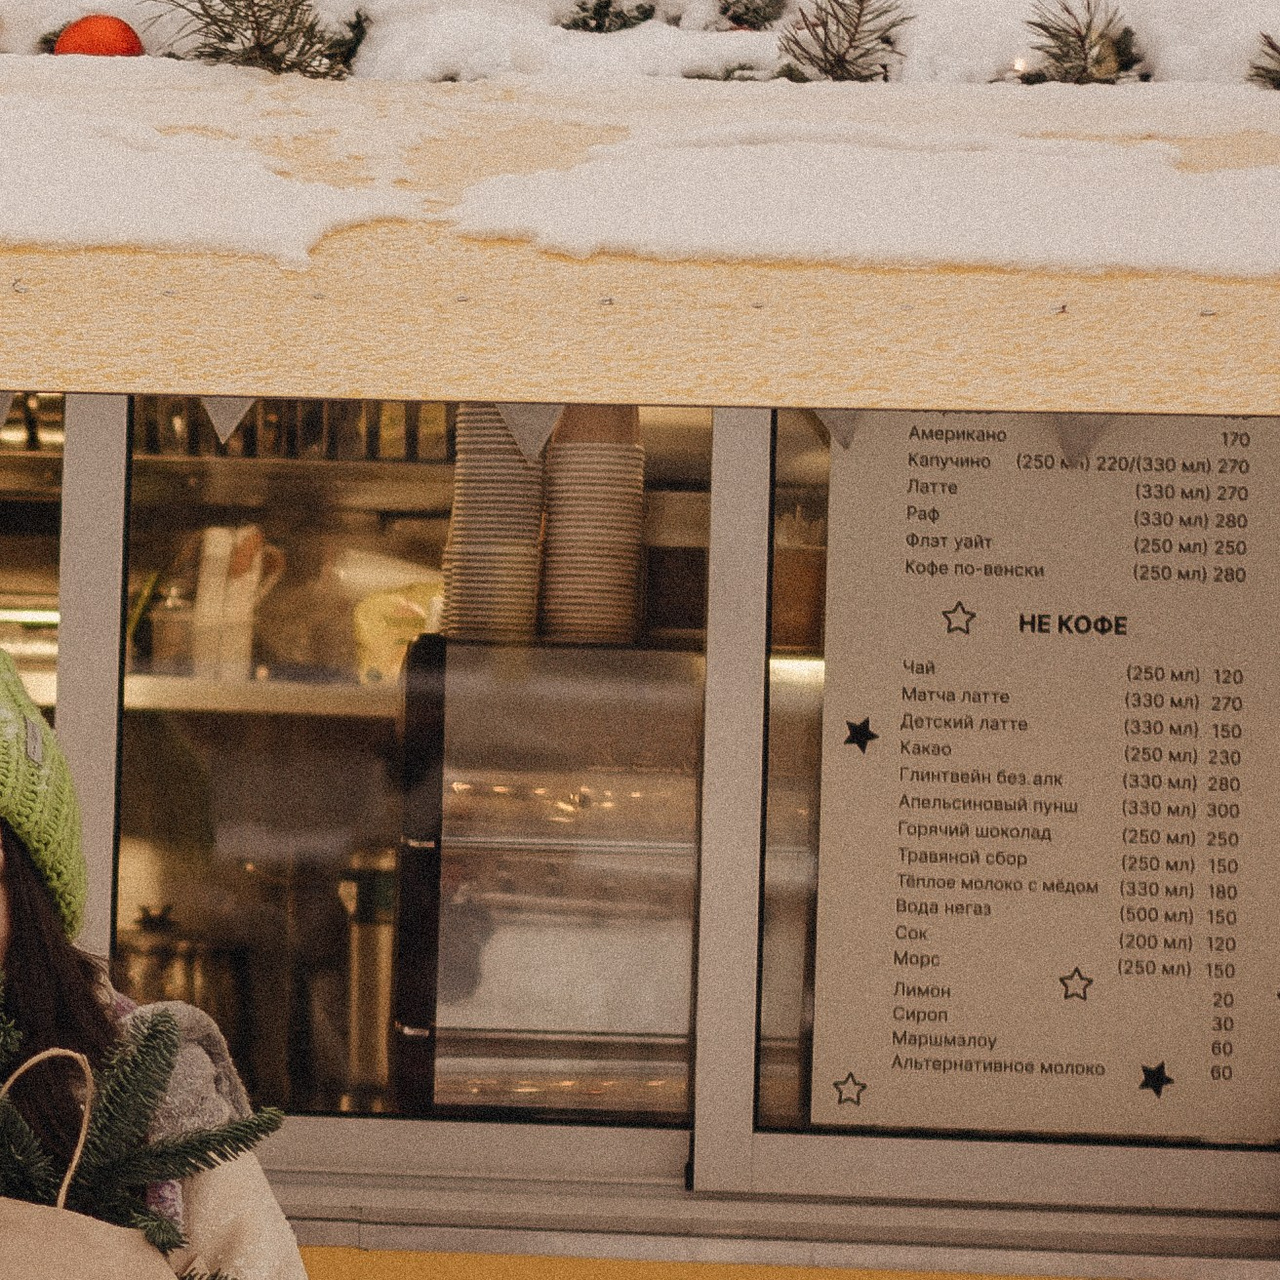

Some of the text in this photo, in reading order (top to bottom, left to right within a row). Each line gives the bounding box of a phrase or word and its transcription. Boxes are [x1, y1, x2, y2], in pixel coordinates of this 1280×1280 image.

[908, 425, 1250, 447] Американо 170
[908, 453, 991, 470] Капучино
[1016, 454, 1055, 470] (250
[1097, 455, 1176, 473] 220/(330
[1181, 457, 1211, 473] мл)
[1217, 459, 1249, 473] 270
[906, 479, 1248, 500] Латте (330 мл) 270
[907, 507, 1248, 528] Раф (330 мл) 280
[906, 533, 1247, 555] Флэт уайт (250 мл) 250
[905, 560, 1246, 583] Кофе по-венски (250 мл) 280
[1020, 614, 1128, 635] НЕ КОФЕ
[903, 660, 1243, 683] Чай (250 мл) 120
[902, 687, 1242, 710] Матча латте (330 мл) 270
[979, 718, 1028, 731] латте
[1124, 721, 1164, 736] (330
[1169, 721, 1198, 737] мл)
[1212, 724, 1241, 738] 150
[900, 740, 1241, 765] Какао (250 мл) 230
[899, 768, 990, 785] Глинтвейн
[1123, 774, 1162, 791] (330
[1167, 775, 1197, 791] мл)
[1208, 776, 1239, 791] 280
[899, 795, 1239, 818] Апельсиновый пунш (330 мл) 300
[898, 822, 1239, 846] Горячий шоколад (250 мл) 250
[899, 848, 1238, 874] Травяной сбор (250 мл) 150
[899, 874, 955, 890] Тёплое
[960, 878, 1022, 891] молоко
[1042, 877, 1098, 895] мёдом
[1120, 881, 1159, 897] (330
[1165, 882, 1194, 899] мл)
[1209, 884, 1237, 900] 180
[896, 899, 1236, 925] Вода негаз (500 мл) 150
[896, 926, 1236, 951] Сок (200 мл) 120
[894, 950, 1235, 978] Морс (250 мл) 150
[894, 983, 1234, 1007] Лимон 20
[893, 1007, 1233, 1031] Сироп 30
[892, 1032, 1233, 1056] Маршмалоу 60
[891, 1055, 1232, 1080] Альтернативное молоко 60
